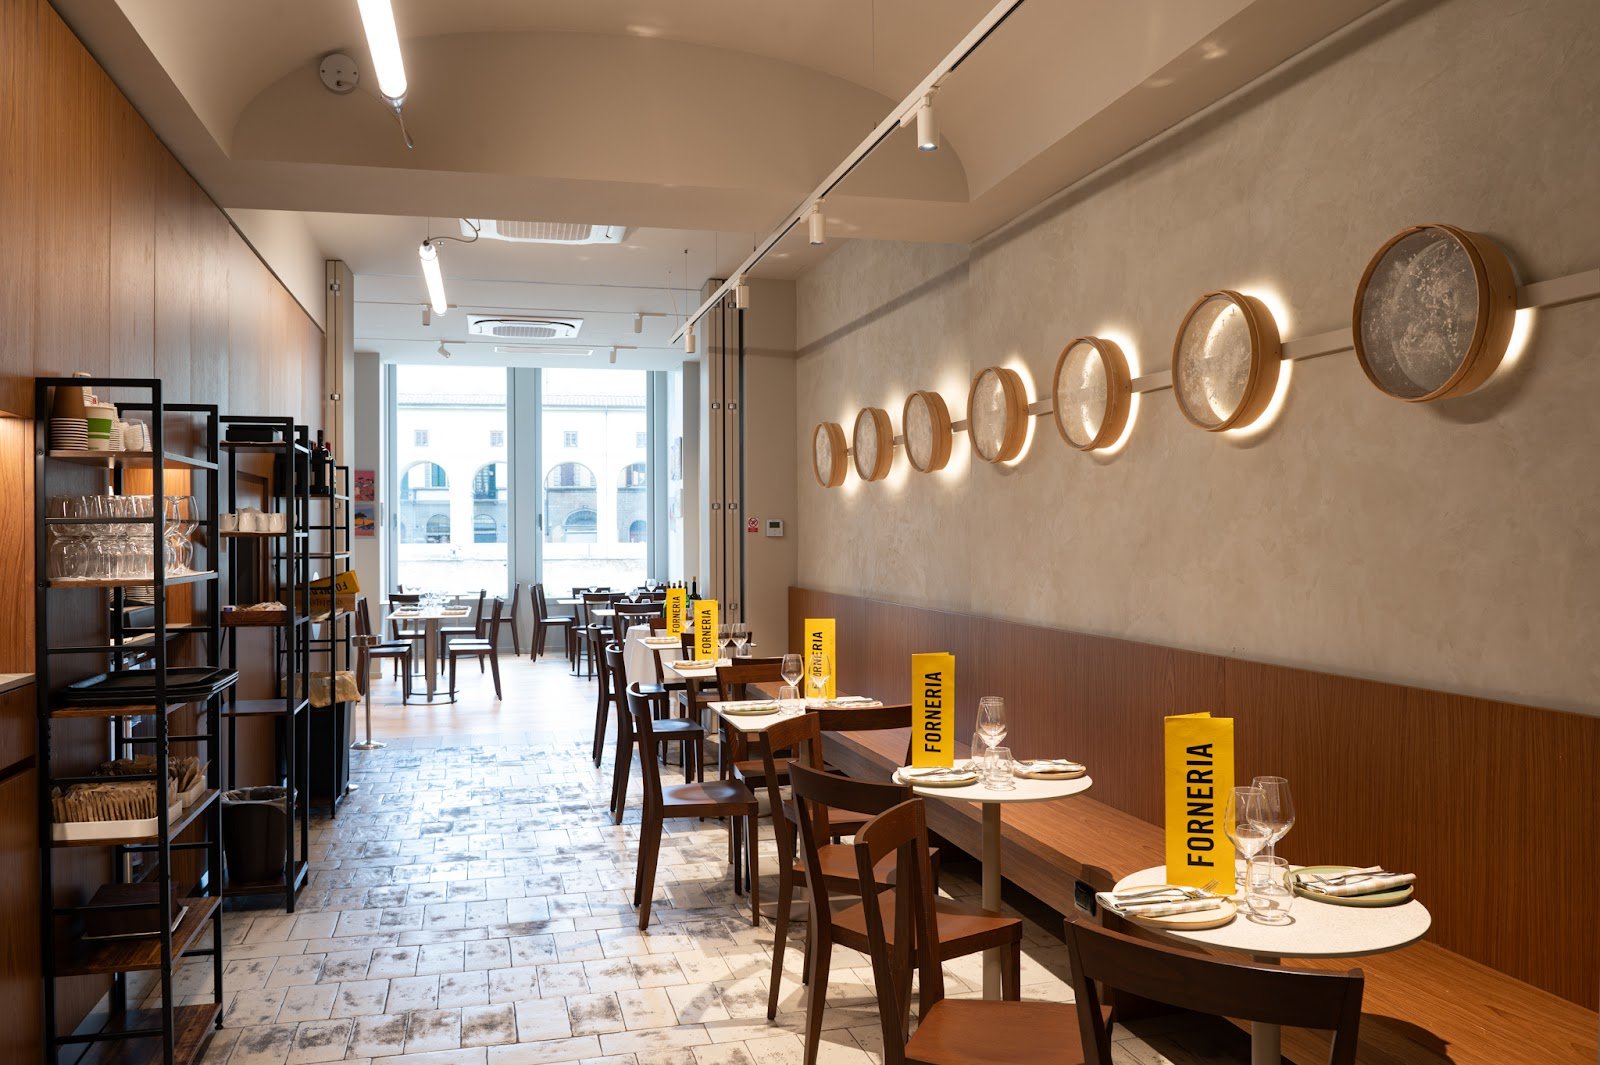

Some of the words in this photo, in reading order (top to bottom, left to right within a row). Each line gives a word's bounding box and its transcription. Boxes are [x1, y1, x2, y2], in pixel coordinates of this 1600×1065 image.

[672, 596, 681, 633] FORNERIA
[702, 609, 711, 654] FORNERIA
[924, 671, 942, 753] FORNERIA
[1186, 743, 1215, 867] FORNERIA
